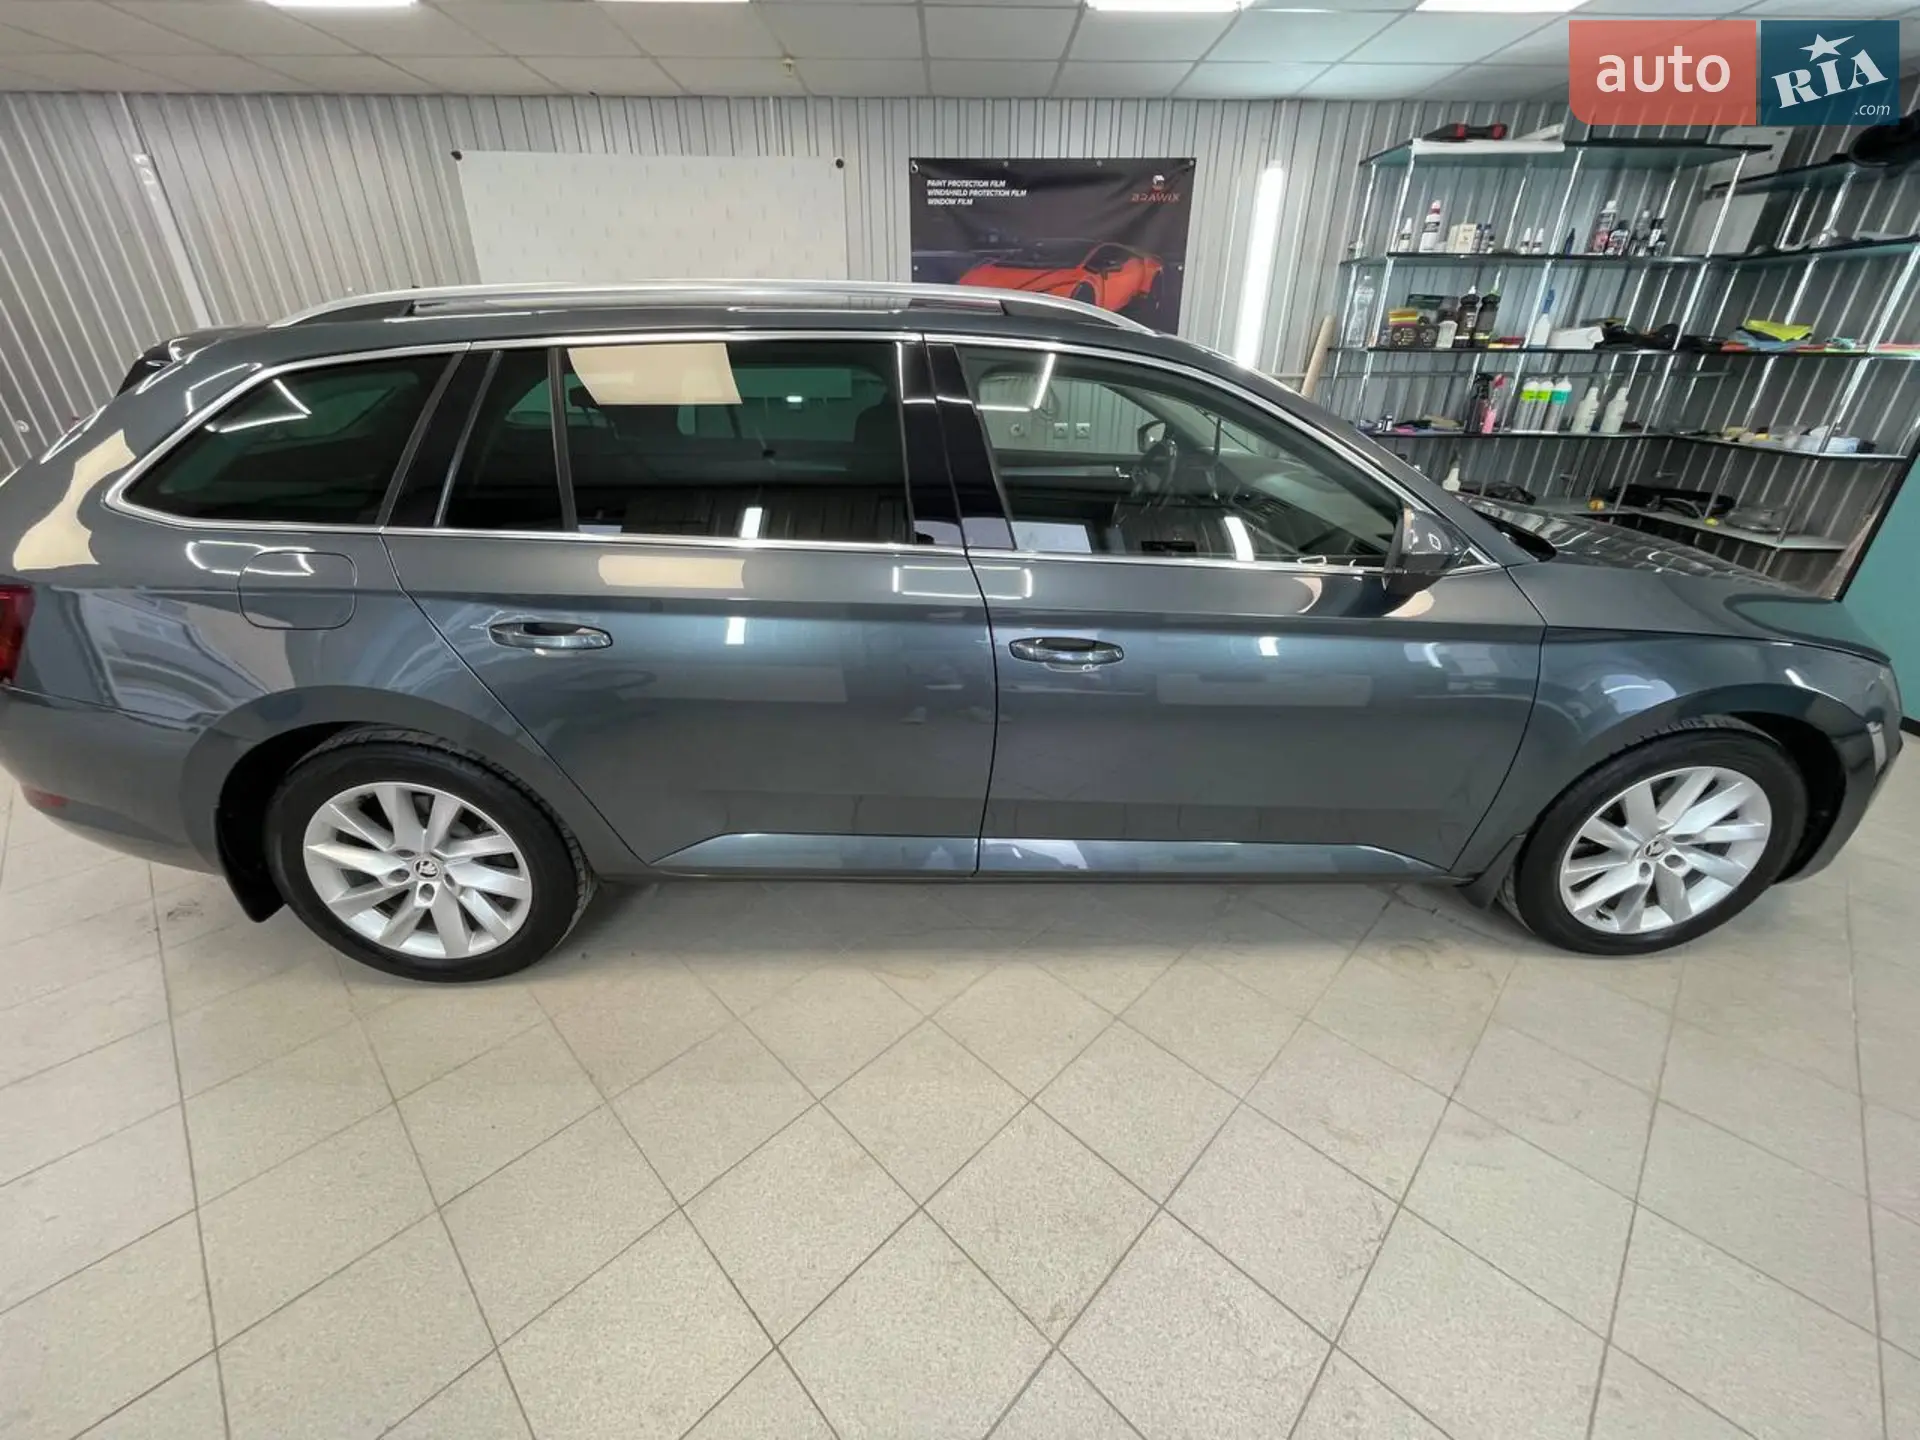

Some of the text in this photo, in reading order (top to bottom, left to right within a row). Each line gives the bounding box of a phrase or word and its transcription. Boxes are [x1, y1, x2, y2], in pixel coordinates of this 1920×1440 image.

[927, 179, 1006, 187] PAINT PROTECTION FILM
[927, 189, 1027, 197] WINDSHIELD PROTECTION FILM
